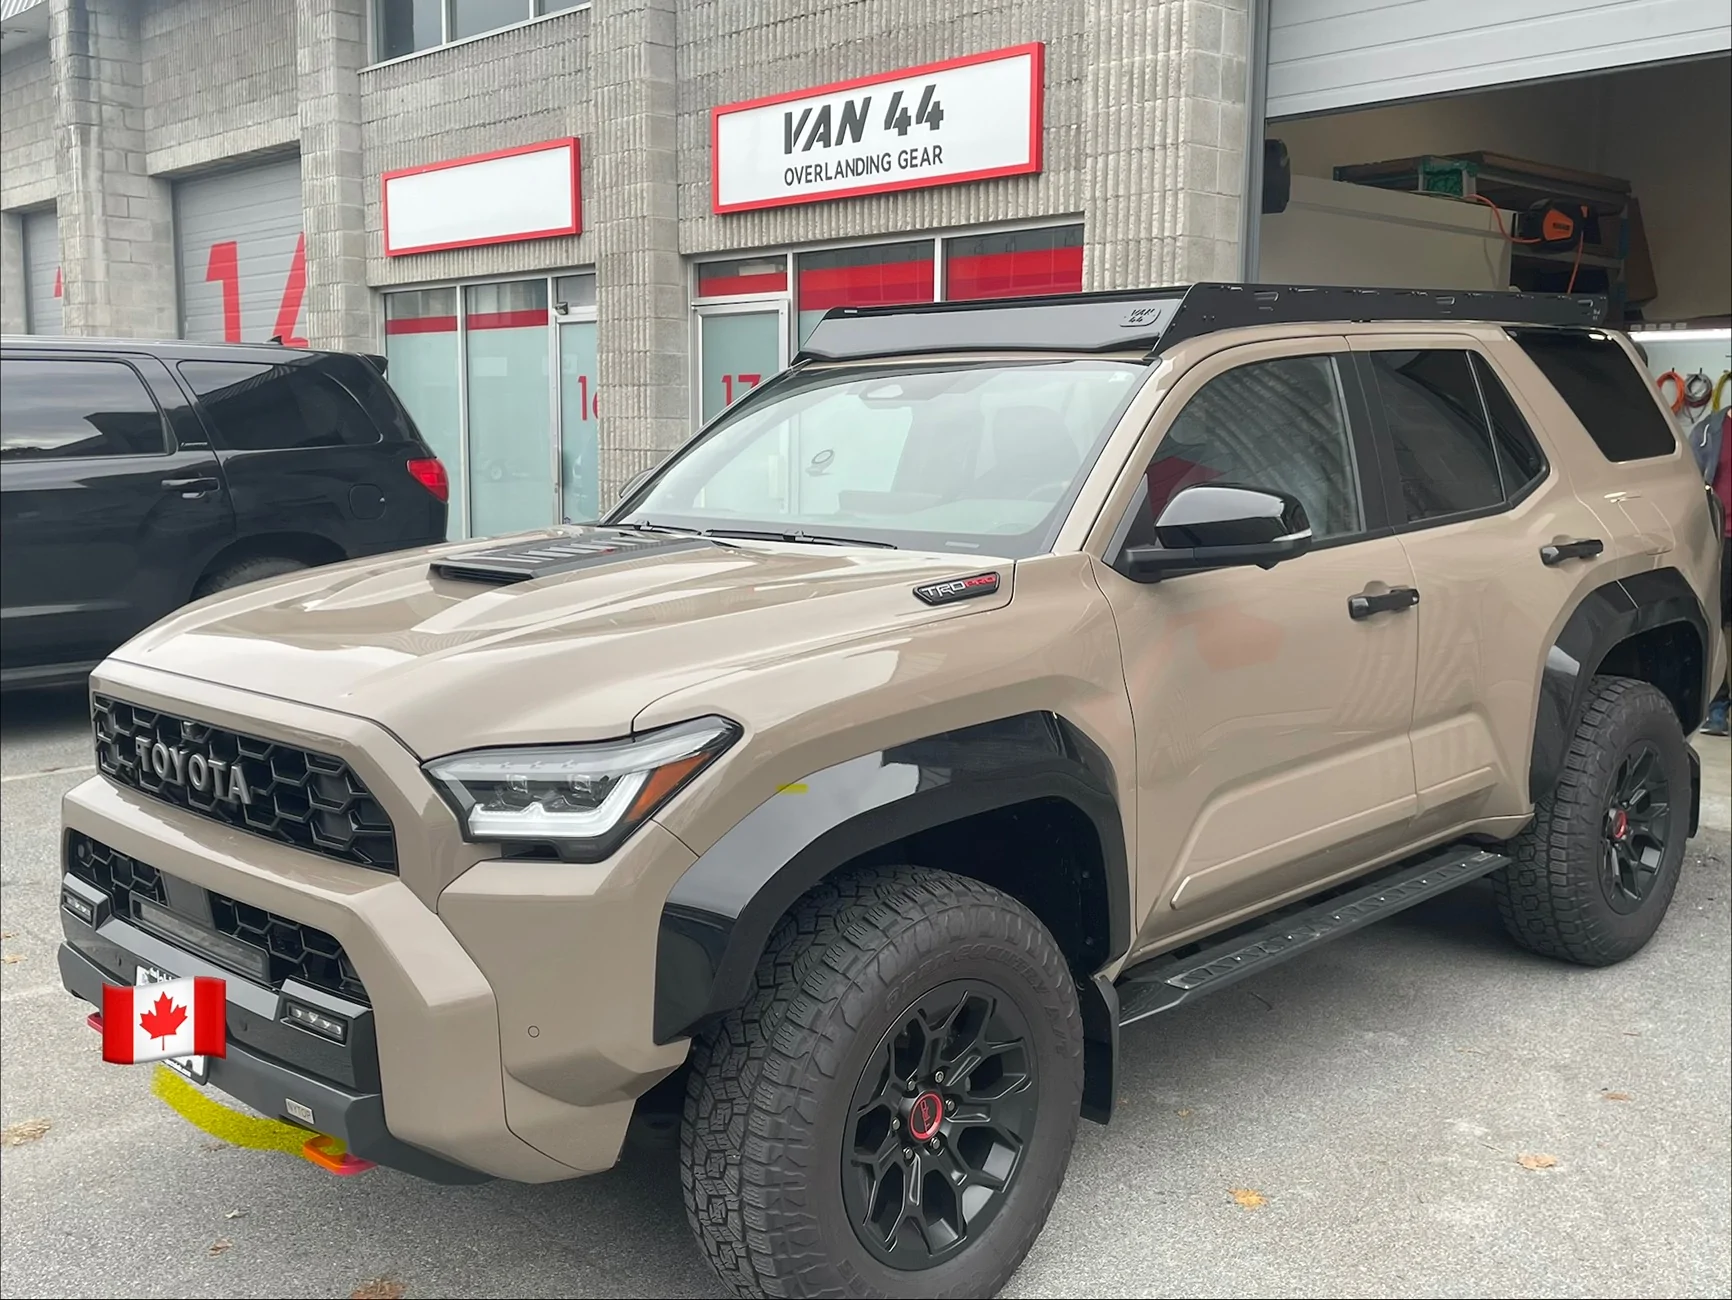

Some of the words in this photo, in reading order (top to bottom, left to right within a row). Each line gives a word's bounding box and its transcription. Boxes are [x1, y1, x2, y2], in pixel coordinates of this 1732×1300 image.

[784, 96, 872, 155] VAN
[884, 84, 944, 136] 44
[784, 152, 892, 186] OVERLANDING
[898, 145, 943, 170] GEAR
[578, 375, 598, 421] 1
[136, 735, 252, 804] TOYOTA
